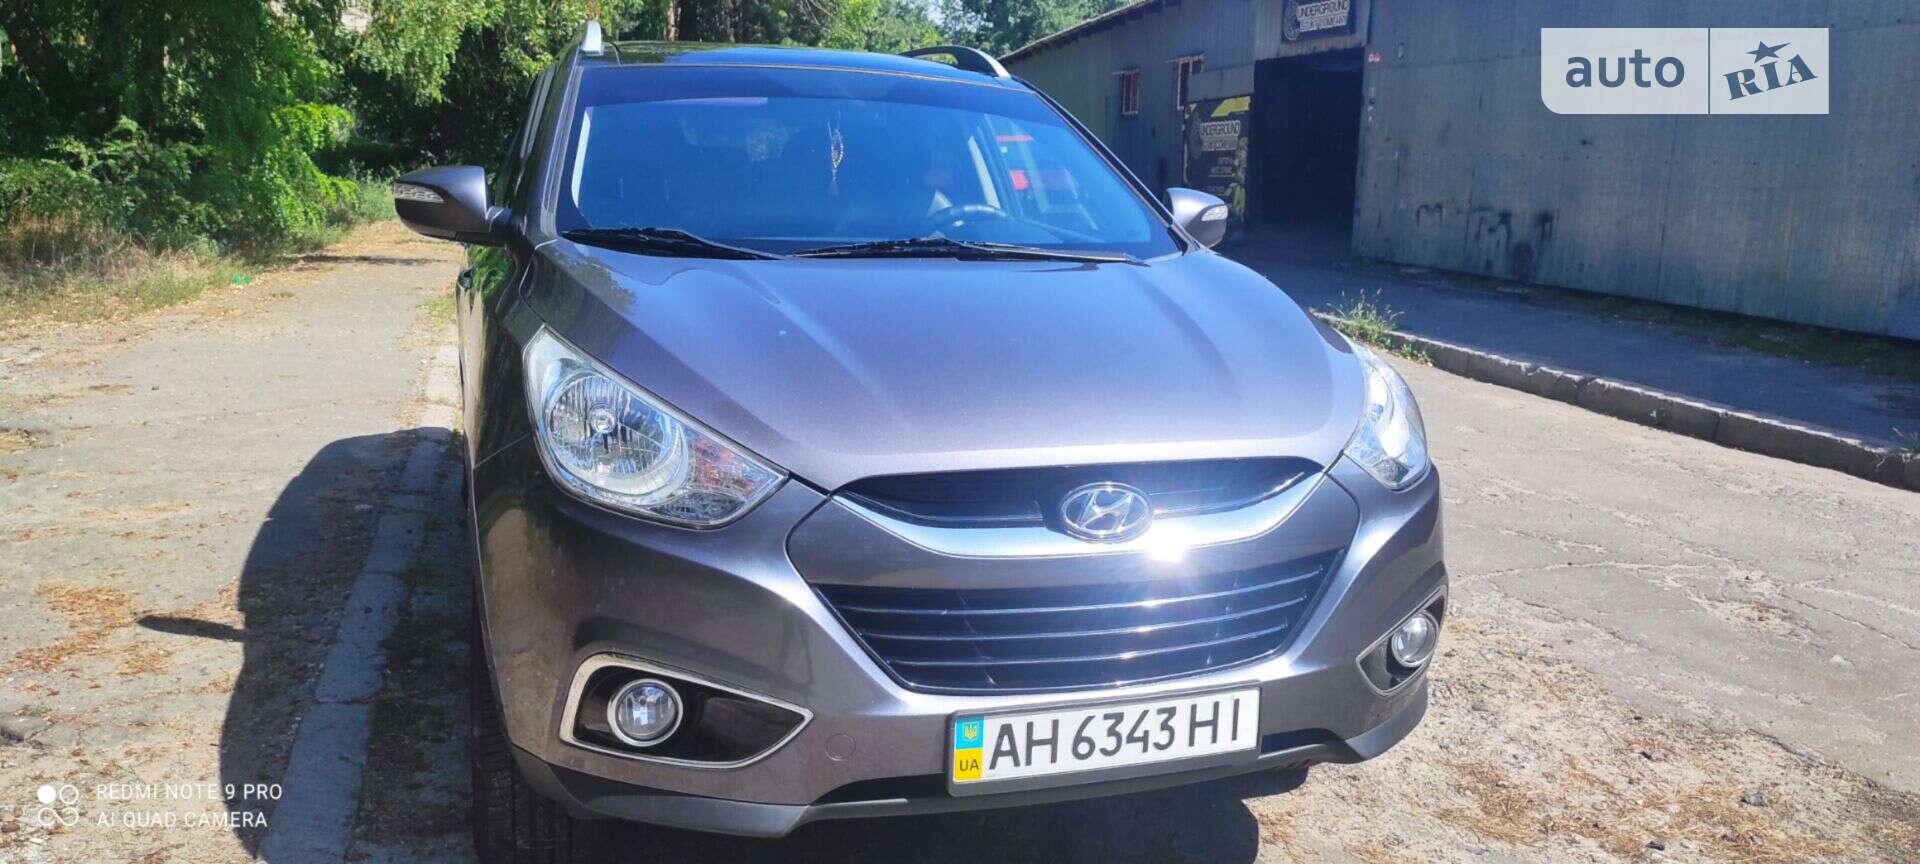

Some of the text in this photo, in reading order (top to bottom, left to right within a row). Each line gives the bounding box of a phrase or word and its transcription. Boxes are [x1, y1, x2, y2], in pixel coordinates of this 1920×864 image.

[988, 698, 1240, 770] AH 6343 HI
[959, 761, 980, 772] UA
